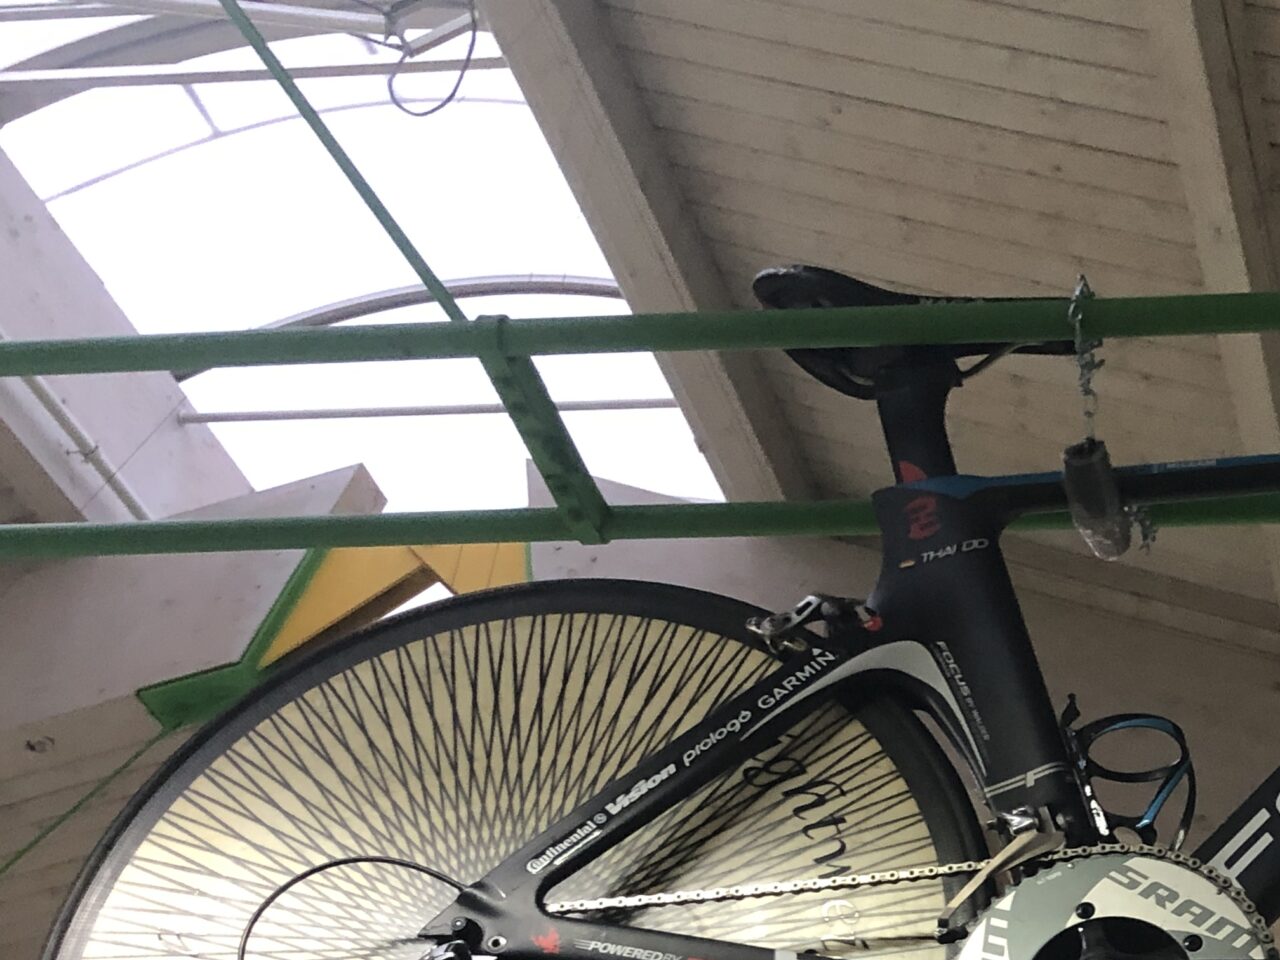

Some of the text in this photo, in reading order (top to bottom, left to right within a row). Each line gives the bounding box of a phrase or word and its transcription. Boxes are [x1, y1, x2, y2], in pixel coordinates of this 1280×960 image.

[921, 538, 989, 563] THAI DO
[936, 641, 971, 696] FOCUS
[605, 763, 677, 815] Vision
[757, 651, 835, 710] GARMIN
[1105, 864, 1260, 960] SRAM
